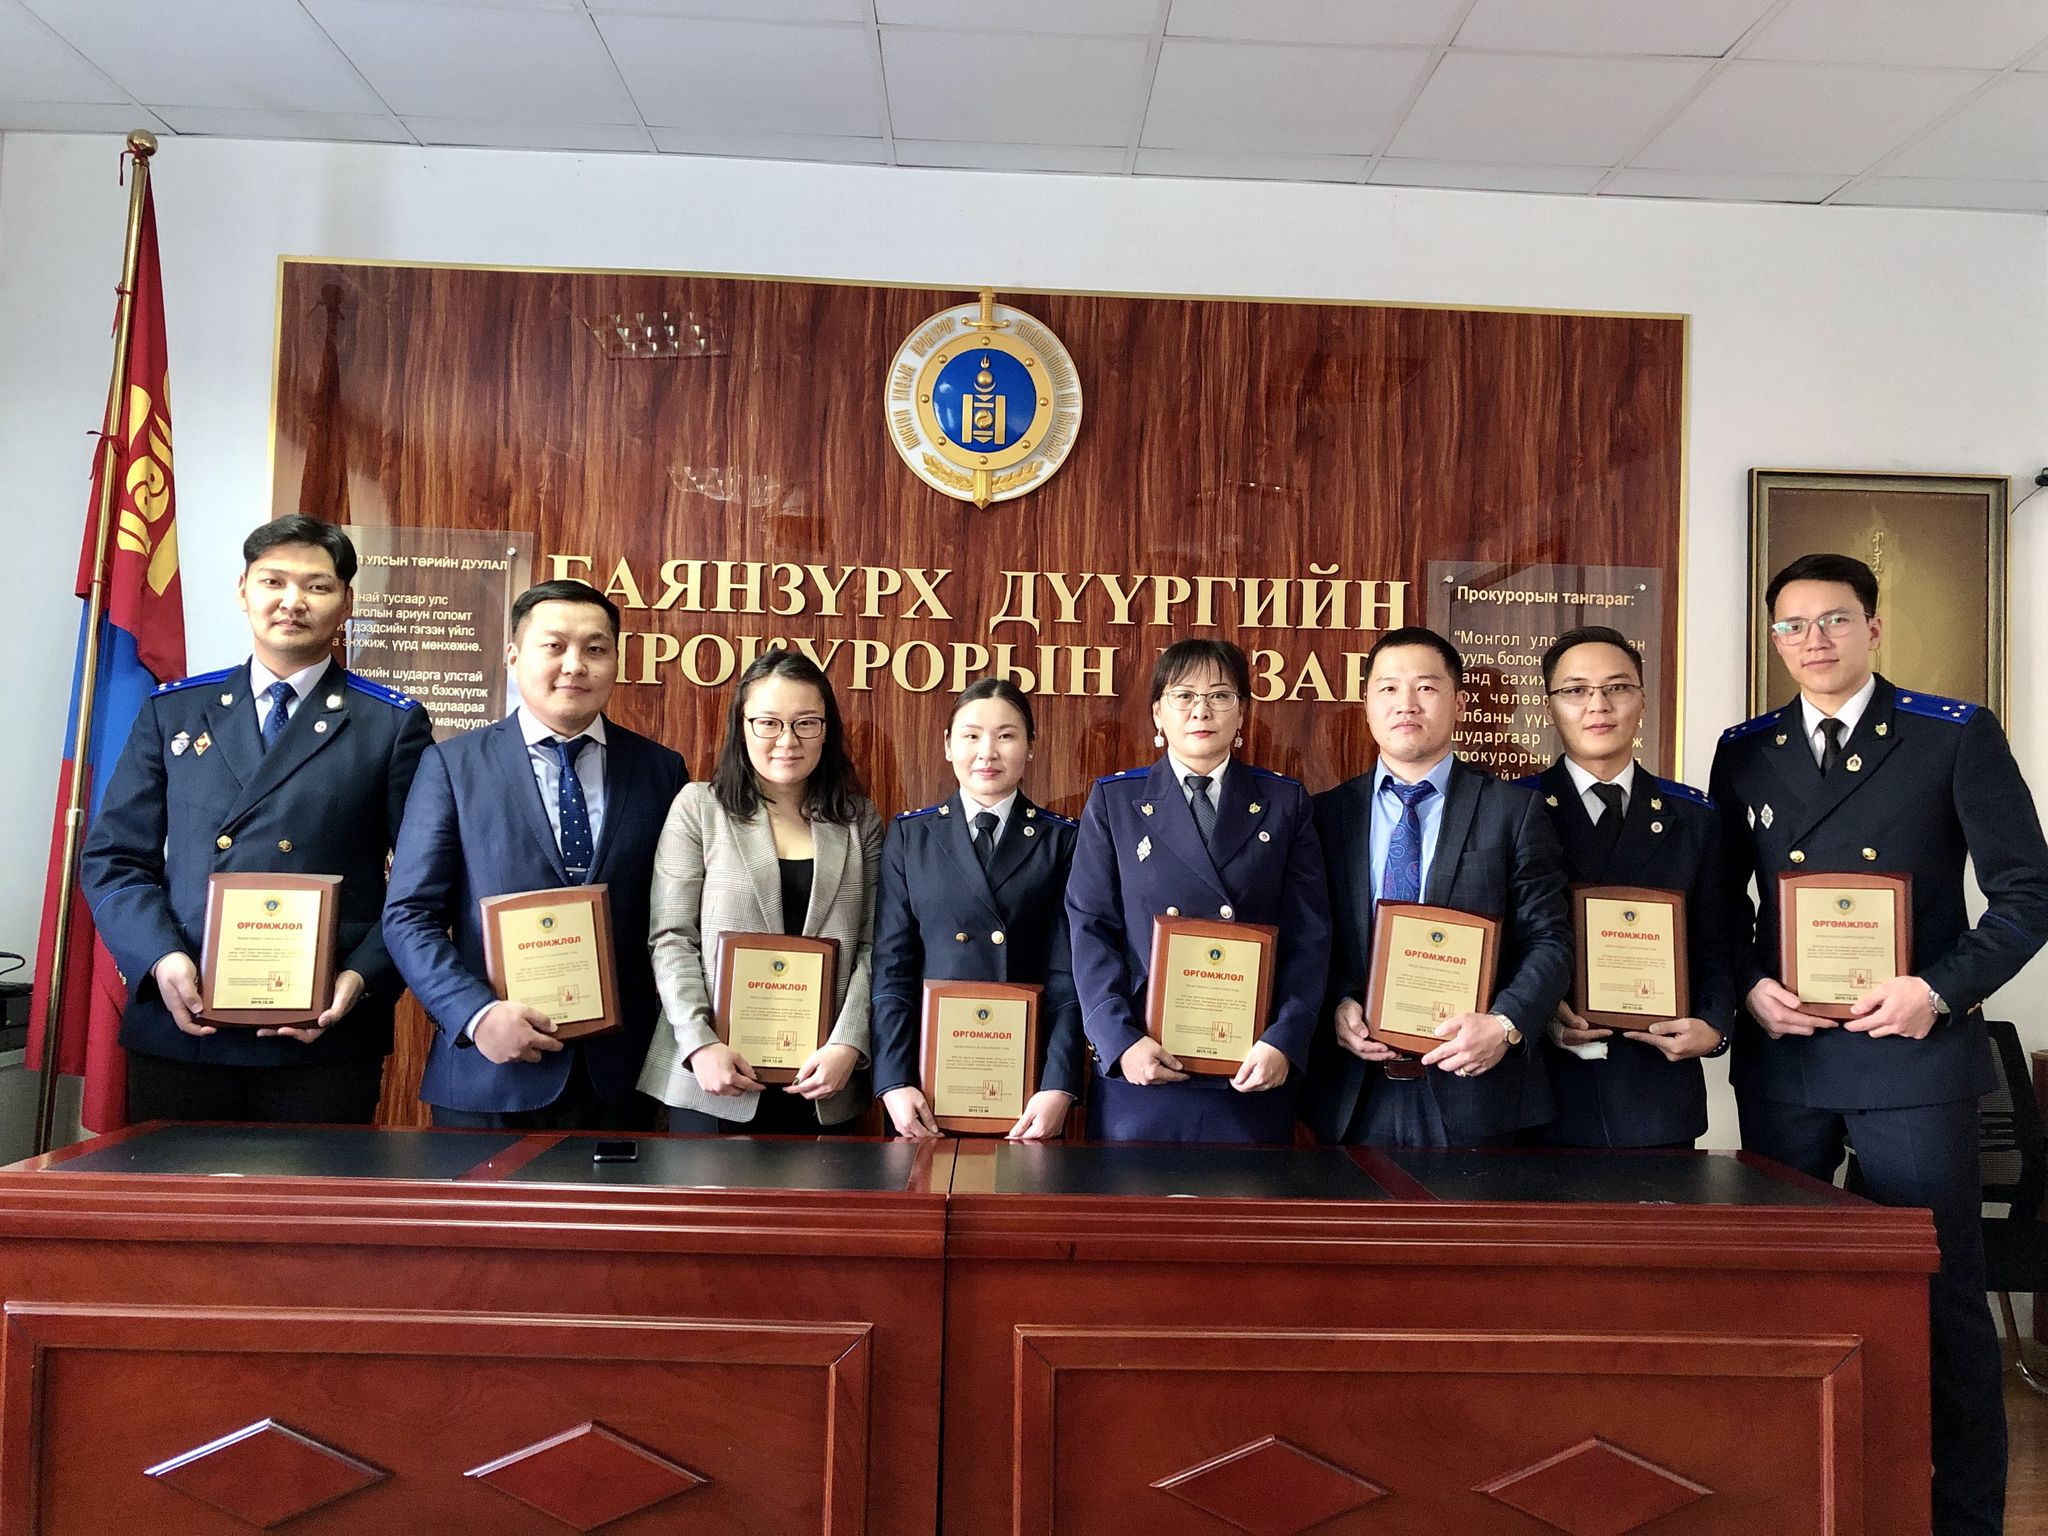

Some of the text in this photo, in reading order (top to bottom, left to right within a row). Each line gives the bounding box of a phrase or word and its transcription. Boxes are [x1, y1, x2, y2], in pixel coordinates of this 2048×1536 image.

[367, 555, 409, 567] УЛСЫН
[411, 556, 459, 569] ТӨРИЙН
[461, 559, 508, 571] ДУУЛАЛ
[383, 593, 426, 606] тусгаар
[429, 596, 449, 606] улс
[989, 562, 1411, 636] ДҮҮРГИЙН
[1457, 585, 1635, 608] Прокурорын тангараг:
[396, 610, 430, 622] ариун
[433, 611, 473, 622] голомт
[352, 622, 407, 635] дээдсийн
[410, 625, 445, 636] гэгээн
[392, 639, 419, 652] үүрд
[1498, 650, 1542, 667] болон
[393, 670, 441, 682] шударга
[444, 670, 483, 683] улстай
[403, 685, 429, 695] эвээ
[1451, 730, 1541, 748] шударгаар
[237, 921, 303, 931] ӨРГӨМЖЛӨЛ
[1811, 919, 1879, 930] ӨРГӨМЖЛӨЛ
[1600, 929, 1660, 942] ӨРГӨМЖЛӨЛ
[517, 935, 582, 951] ӨРГӨМЖЛӨЛ
[1404, 948, 1467, 966] ӨРГӨМЖЛӨЛ
[1182, 968, 1244, 983] ӨРГӨМЖЛӨЛ
[747, 980, 808, 992] ӨРГӨМЖЛӨЛ
[952, 1029, 1012, 1041] ӨРГӨМЖЛӨЛ
